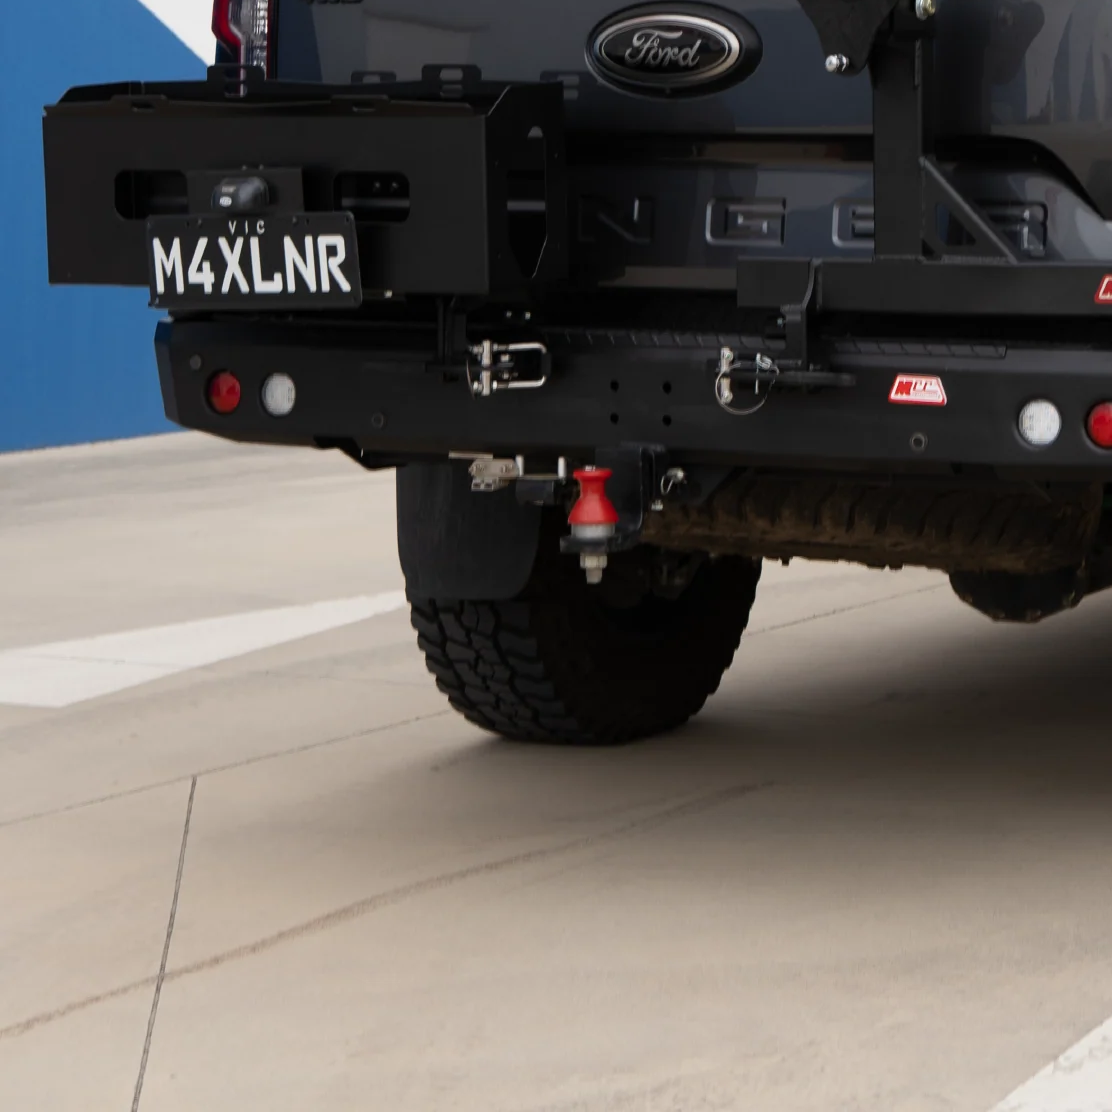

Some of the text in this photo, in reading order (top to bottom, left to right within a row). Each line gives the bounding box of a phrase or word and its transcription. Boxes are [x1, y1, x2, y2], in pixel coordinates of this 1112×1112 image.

[625, 29, 702, 67] Ford
[229, 219, 266, 236] VIC
[153, 234, 352, 295] M4XLNR
